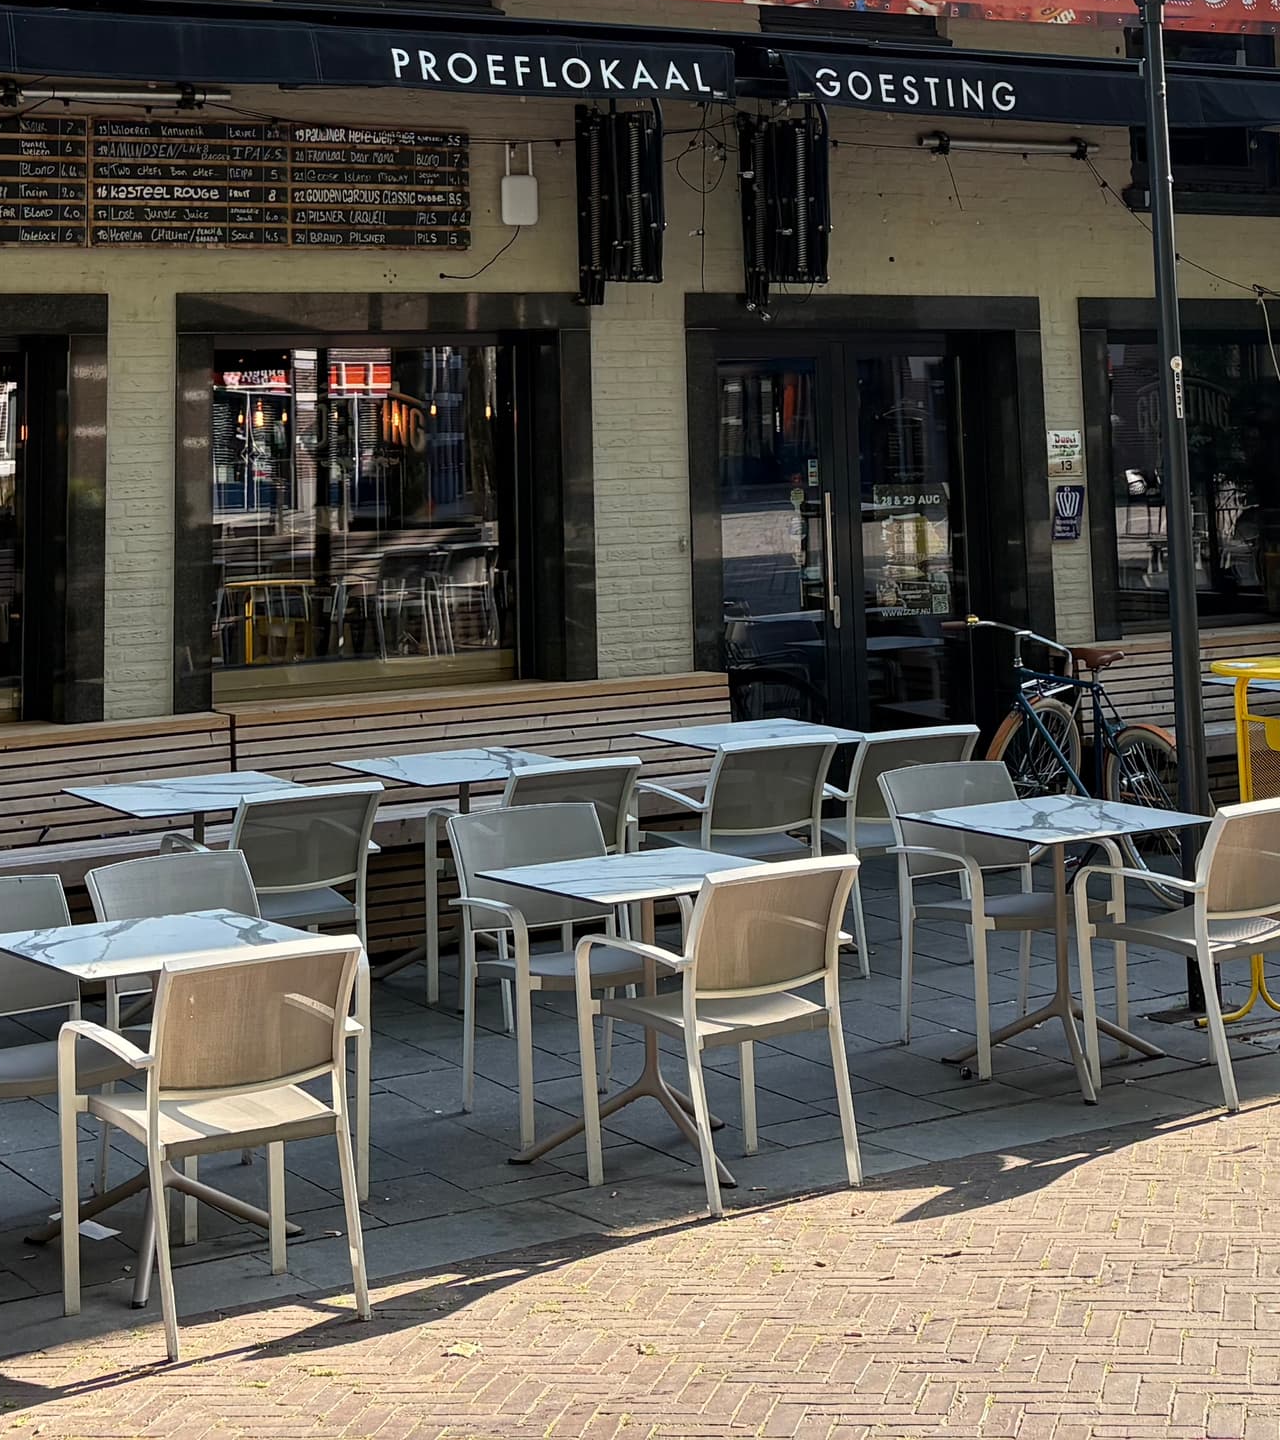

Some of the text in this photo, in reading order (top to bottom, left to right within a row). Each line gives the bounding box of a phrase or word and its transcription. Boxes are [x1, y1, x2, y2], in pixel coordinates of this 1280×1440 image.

[390, 47, 713, 93] PROEFLOKAAL
[815, 67, 1017, 112] GOESTING
[295, 128, 305, 142] 19
[65, 141, 73, 153] 6
[231, 146, 260, 160] IPA
[452, 153, 461, 167] 7
[270, 169, 278, 180] 5
[293, 171, 304, 181] 21
[96, 185, 107, 198] 16
[268, 189, 277, 202] 8
[293, 191, 305, 203] 22
[295, 211, 306, 223] 23
[308, 210, 346, 224] PILSNER
[65, 228, 74, 240] 6
[309, 231, 344, 245] BRAND
[349, 231, 387, 244] PILSNER
[417, 233, 439, 244] PILS
[448, 232, 458, 245] 5
[1061, 459, 1073, 471] 13
[881, 495, 893, 506] 28
[903, 495, 916, 506] 29
[918, 494, 941, 506] AUG
